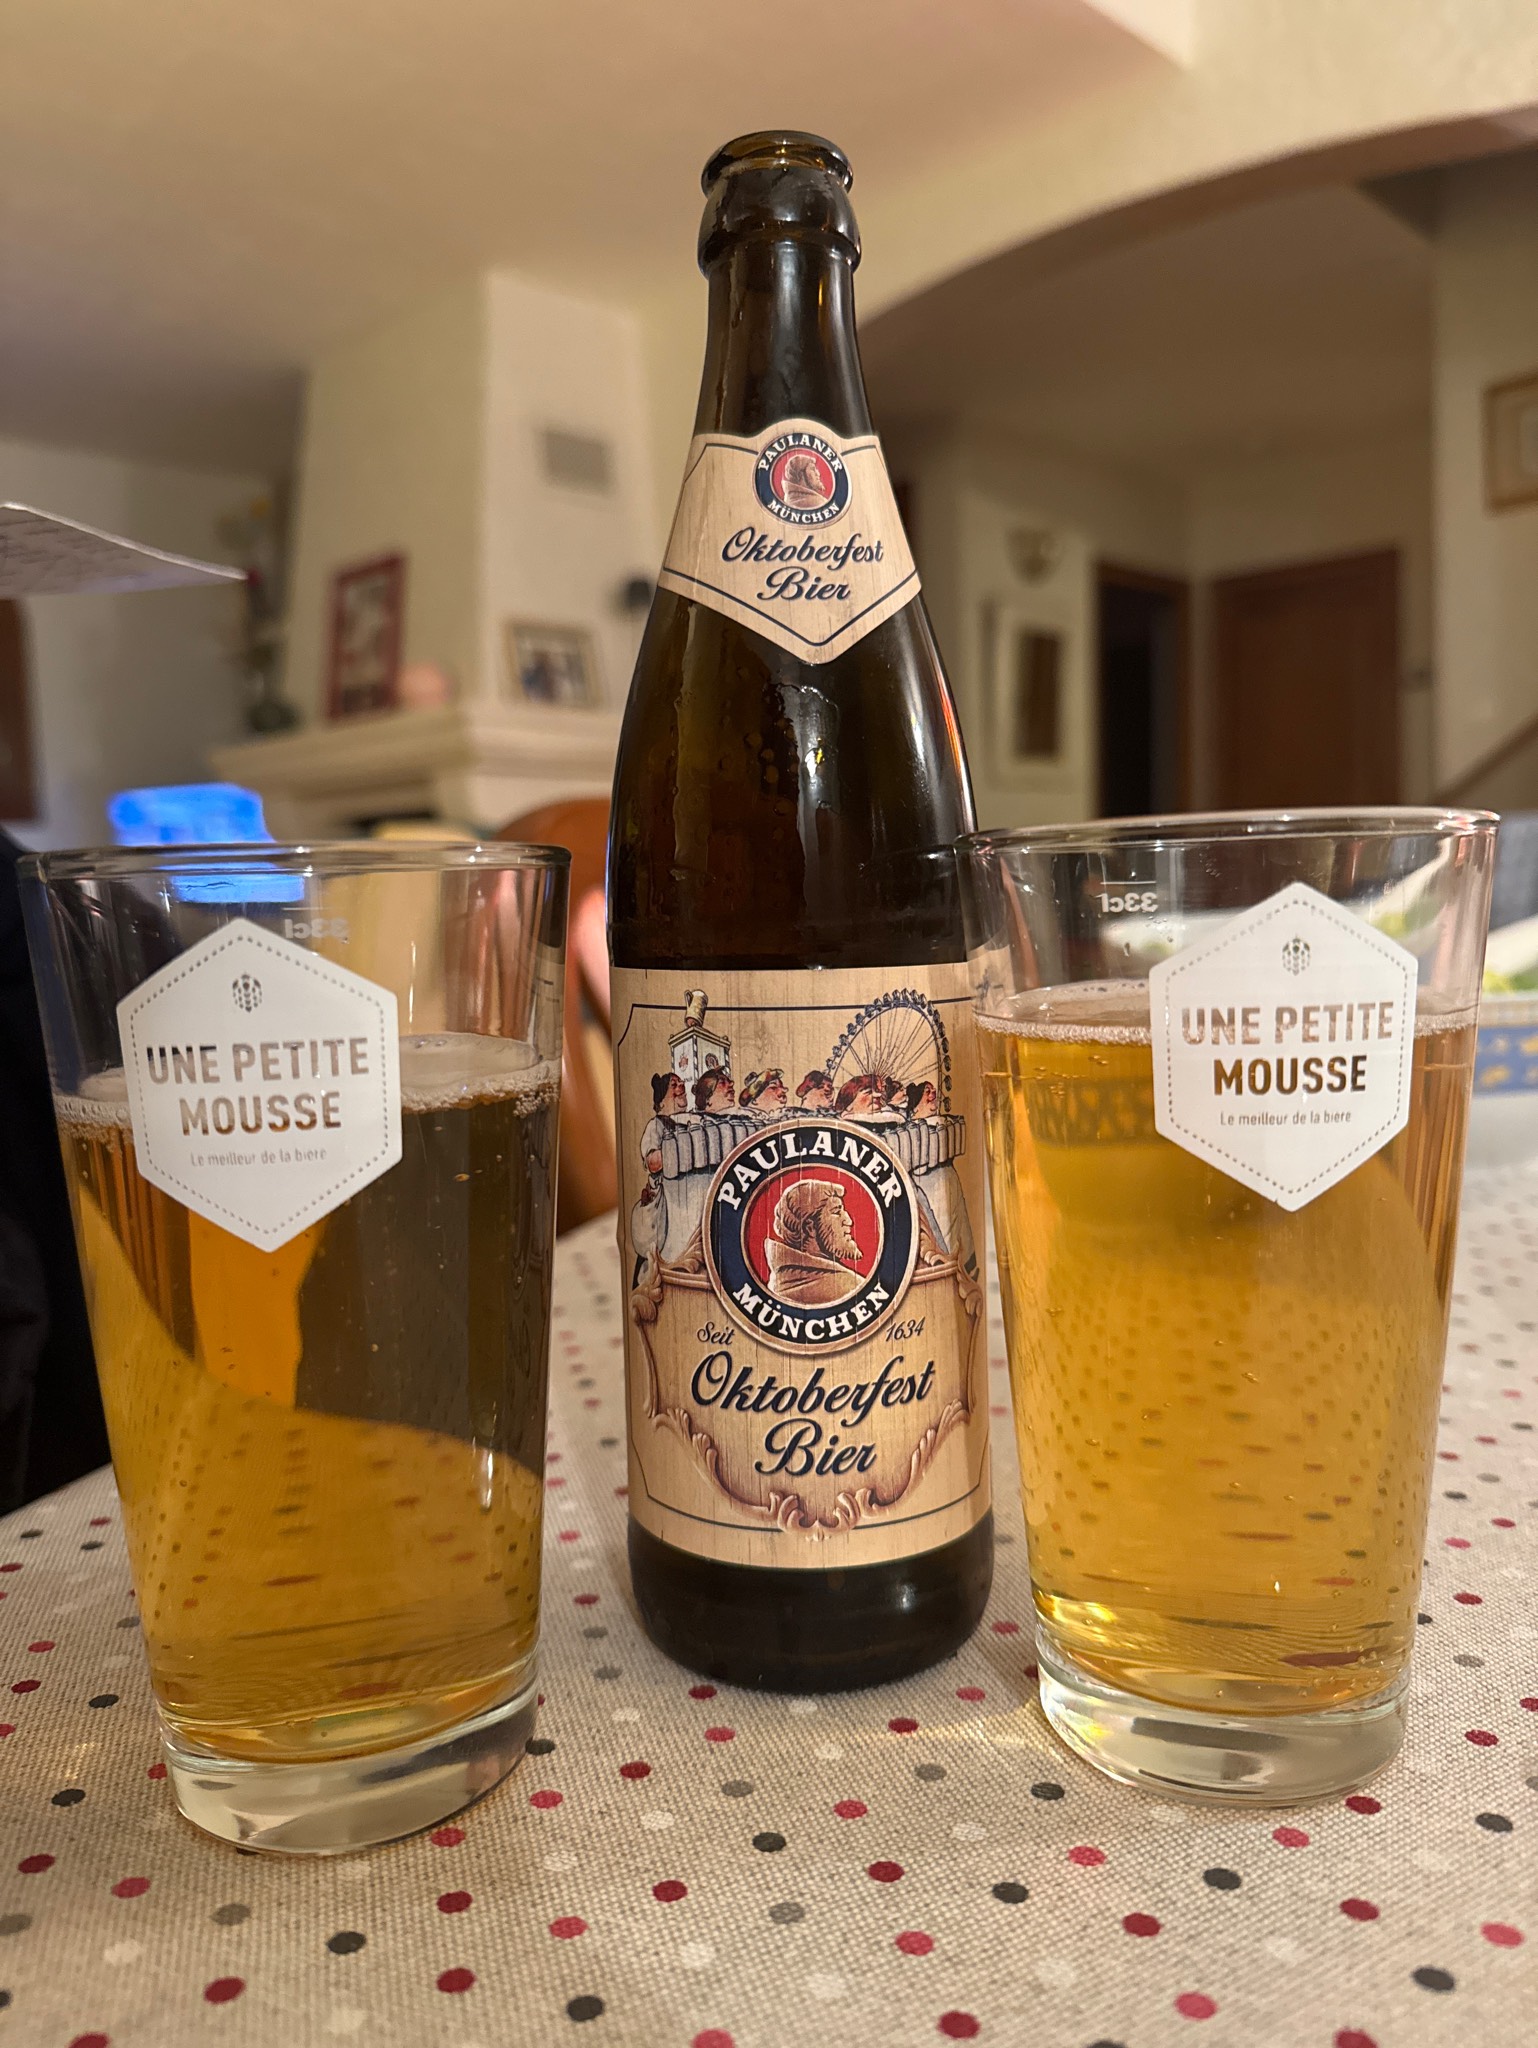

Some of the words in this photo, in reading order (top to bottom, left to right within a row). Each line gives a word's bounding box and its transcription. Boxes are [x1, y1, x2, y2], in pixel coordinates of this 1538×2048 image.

[758, 434, 842, 471] PAULANER
[767, 499, 840, 524] MÜNCHEN
[721, 527, 883, 570] Oktoberfest
[756, 566, 851, 600] Bier
[1182, 1006, 1261, 1046] UNE
[1274, 1001, 1394, 1044] PETITE
[146, 1045, 220, 1084] UNE
[232, 1037, 369, 1082] PETITE
[1213, 1055, 1367, 1096] MOUSSE
[178, 1091, 342, 1136] MOUSSE
[1220, 1111, 1234, 1126] Le
[1239, 1112, 1288, 1126] meilleur
[1292, 1111, 1307, 1125] de
[1310, 1110, 1320, 1124] la
[191, 1151, 204, 1167] Le
[208, 1151, 256, 1166] meilleur
[260, 1149, 276, 1165] de
[280, 1148, 291, 1163] la
[717, 1131, 903, 1211] PAULANER
[697, 1321, 735, 1345] Seit
[885, 1316, 926, 1343] 1634
[732, 1282, 890, 1341] MÜNCHEN
[690, 1350, 936, 1428] Oktoberfest
[754, 1417, 877, 1477] Bier
